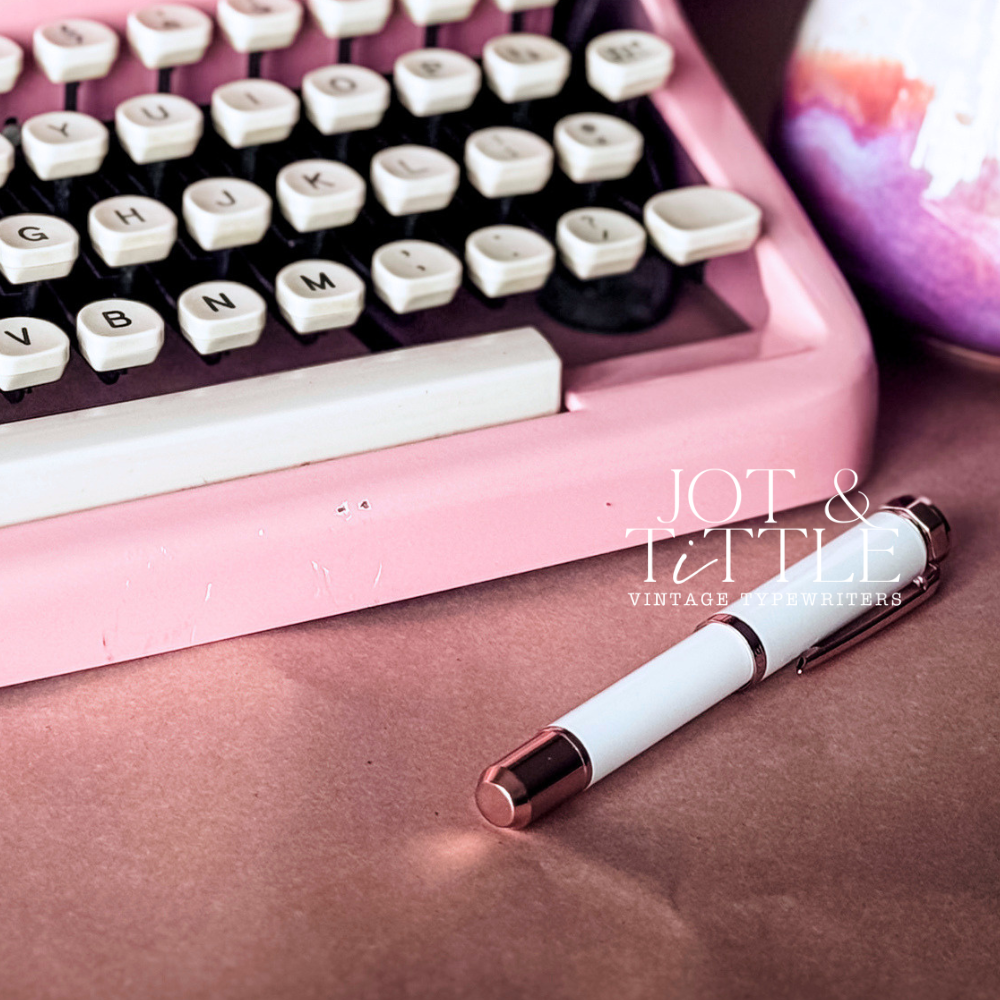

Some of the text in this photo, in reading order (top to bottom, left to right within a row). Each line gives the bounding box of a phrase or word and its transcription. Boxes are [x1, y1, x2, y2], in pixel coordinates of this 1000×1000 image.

[329, 77, 357, 95] O
[141, 106, 170, 122] U
[47, 122, 71, 138] Y
[397, 158, 430, 176] L
[303, 171, 335, 190] K
[214, 190, 236, 207] J
[114, 207, 146, 226] H
[17, 226, 49, 243] G
[300, 272, 336, 292] M
[202, 292, 237, 313] N
[102, 311, 133, 329] B
[4, 327, 32, 346] V
